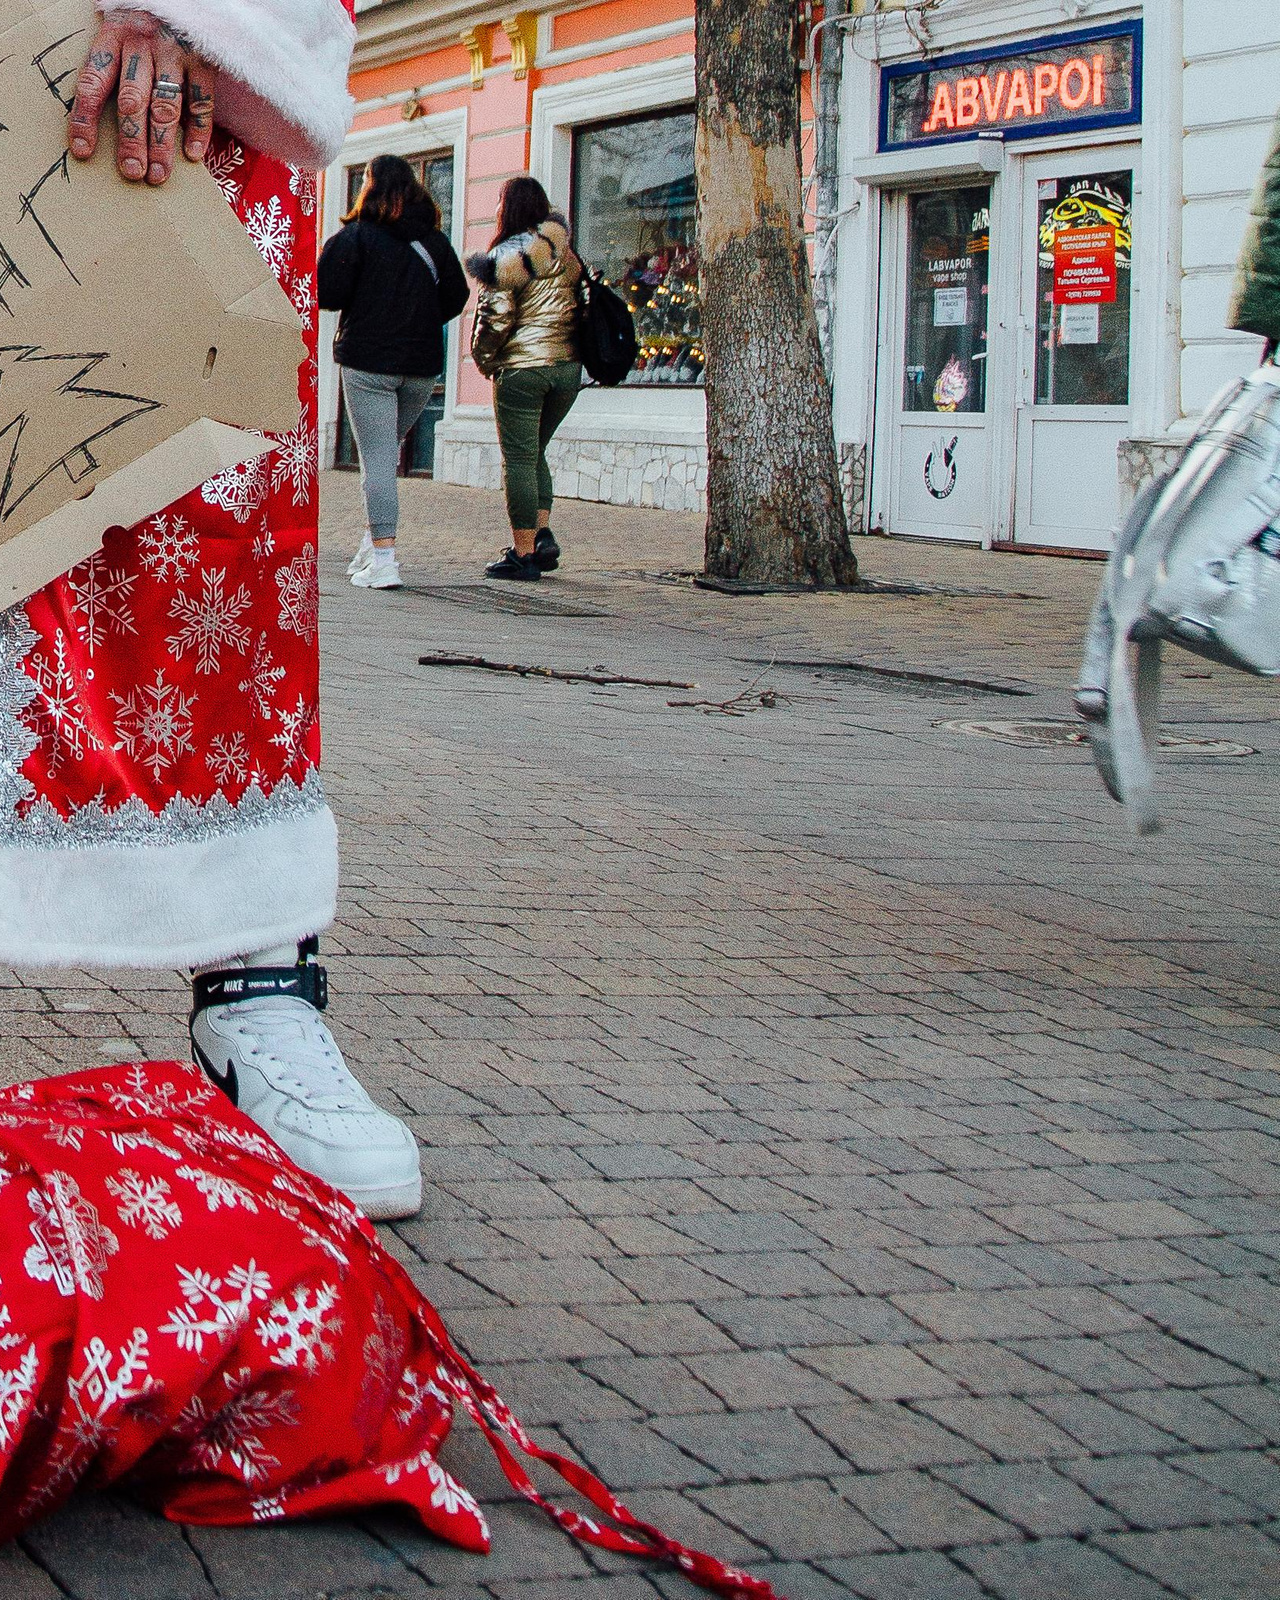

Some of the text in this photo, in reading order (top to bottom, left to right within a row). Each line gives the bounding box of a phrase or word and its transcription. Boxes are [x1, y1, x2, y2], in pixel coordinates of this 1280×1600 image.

[928, 258, 972, 272] LABVAPOR
[1071, 256, 1096, 265] Адвокат
[932, 272, 968, 283] vape shop
[223, 979, 244, 992] NIKE
